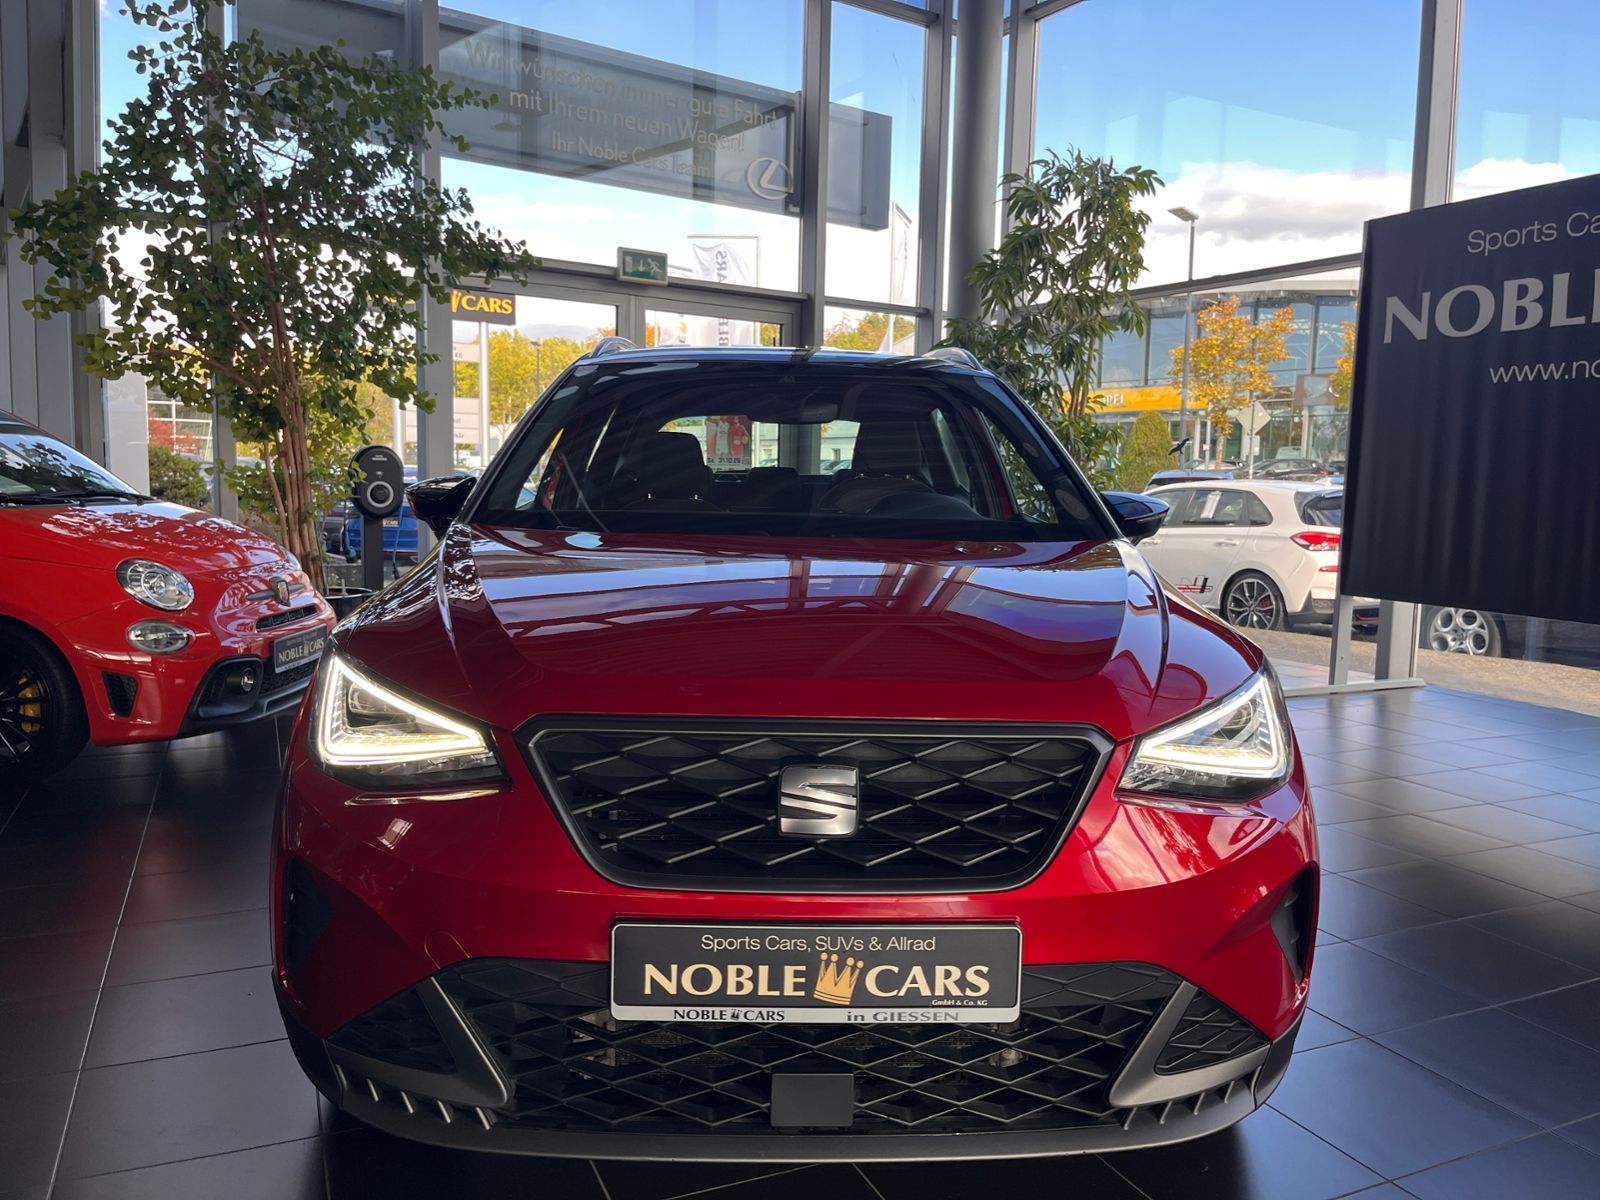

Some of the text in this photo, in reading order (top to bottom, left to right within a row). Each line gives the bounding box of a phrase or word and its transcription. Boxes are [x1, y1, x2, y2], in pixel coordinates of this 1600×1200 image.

[512, 57, 615, 96] wünschen
[622, 79, 683, 108] immer
[690, 98, 729, 118] gute
[509, 89, 745, 152] mit Ihrem neuen Wagen!
[552, 130, 710, 177] Ihr Noble Cars Team
[1467, 212, 1600, 256] Sports Ca
[461, 295, 513, 314] CARS
[278, 645, 303, 663] NOBLE
[309, 637, 325, 652] CARS
[701, 934, 936, 952] Sports Cars, SUVs & Allrad
[644, 963, 990, 997] NOBLE CARS
[674, 1009, 785, 1021] NOBLE CARS
[847, 1011, 959, 1022] in GIESSEN
